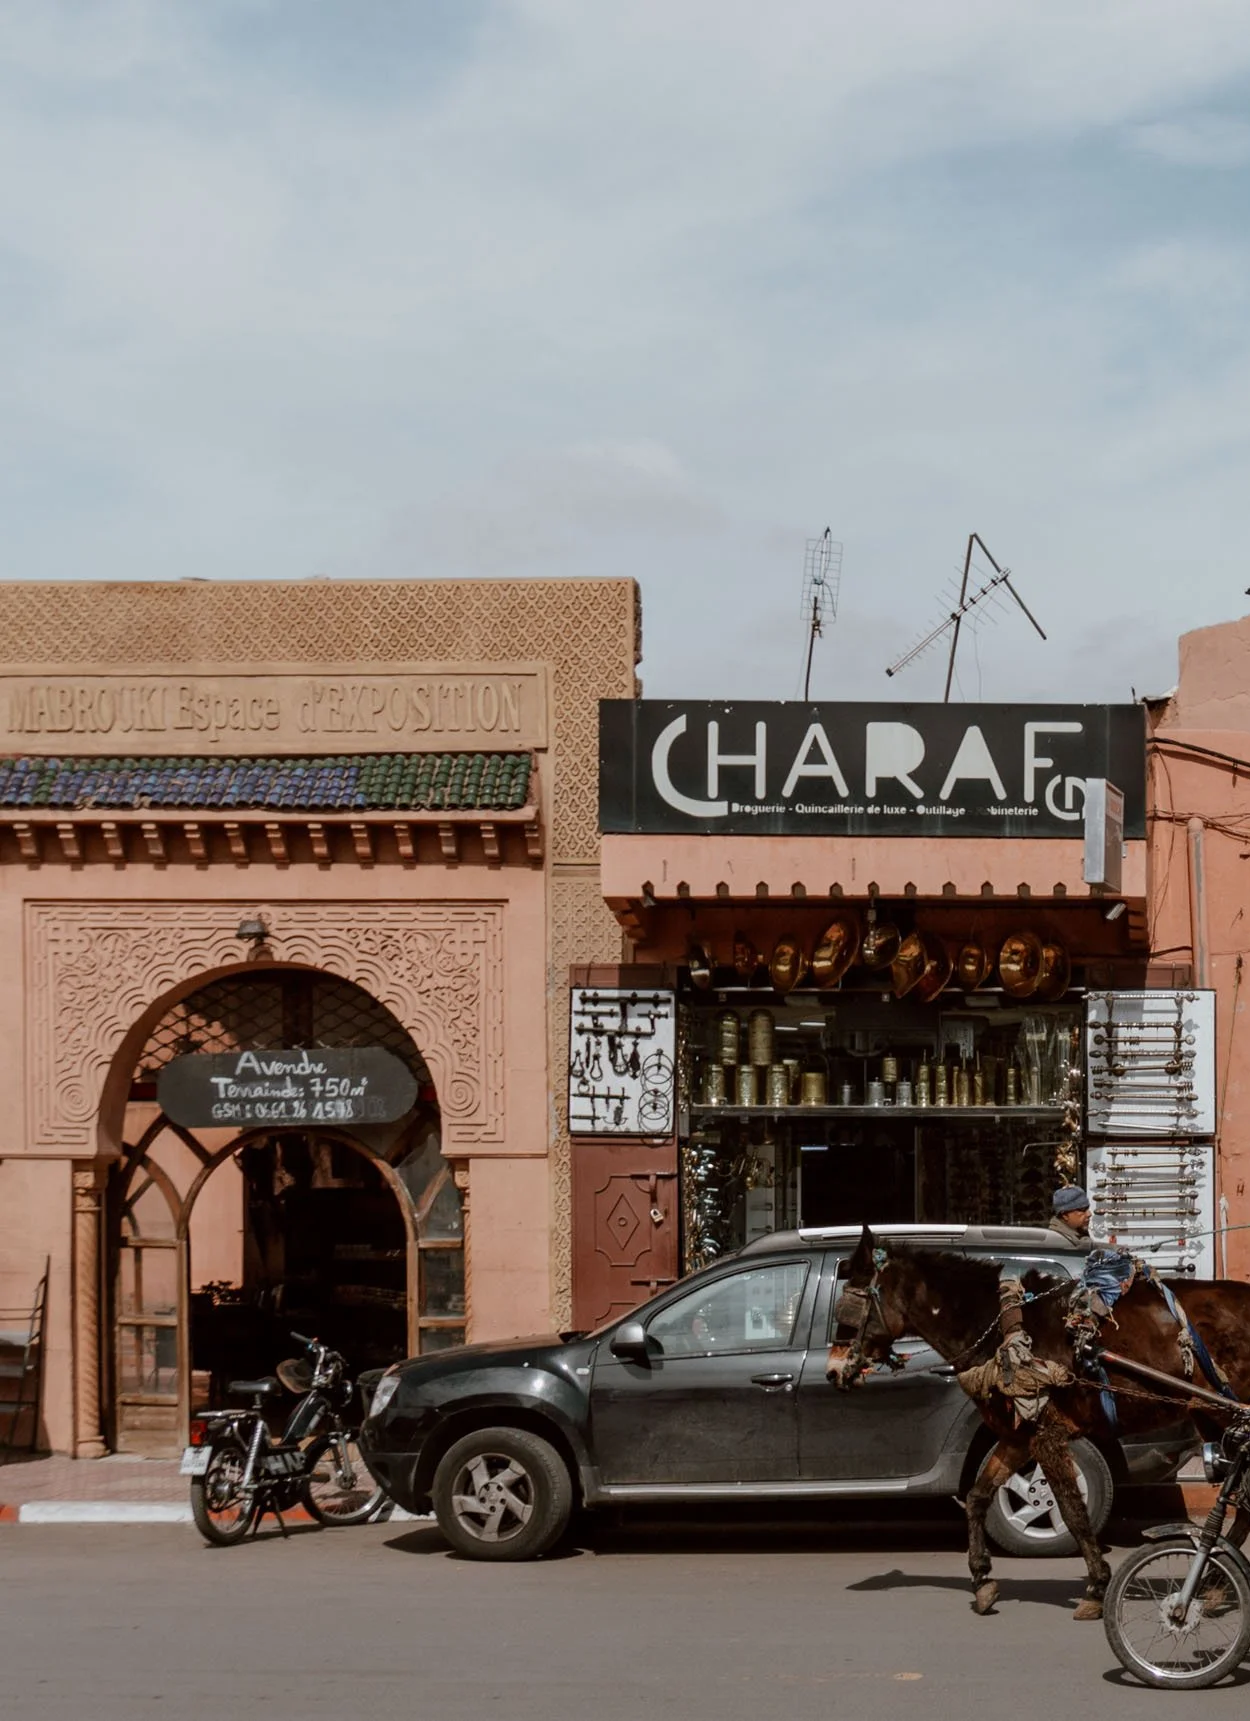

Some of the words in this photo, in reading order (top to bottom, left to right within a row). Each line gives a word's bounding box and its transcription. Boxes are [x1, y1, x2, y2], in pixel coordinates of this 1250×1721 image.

[174, 686, 281, 743] Espace
[651, 713, 1083, 818] CHARAF
[732, 803, 786, 815] Droguerie
[795, 803, 864, 814] Quincaillerie
[867, 804, 881, 815] de
[883, 804, 907, 815] luxe
[977, 804, 1039, 817] bineterie
